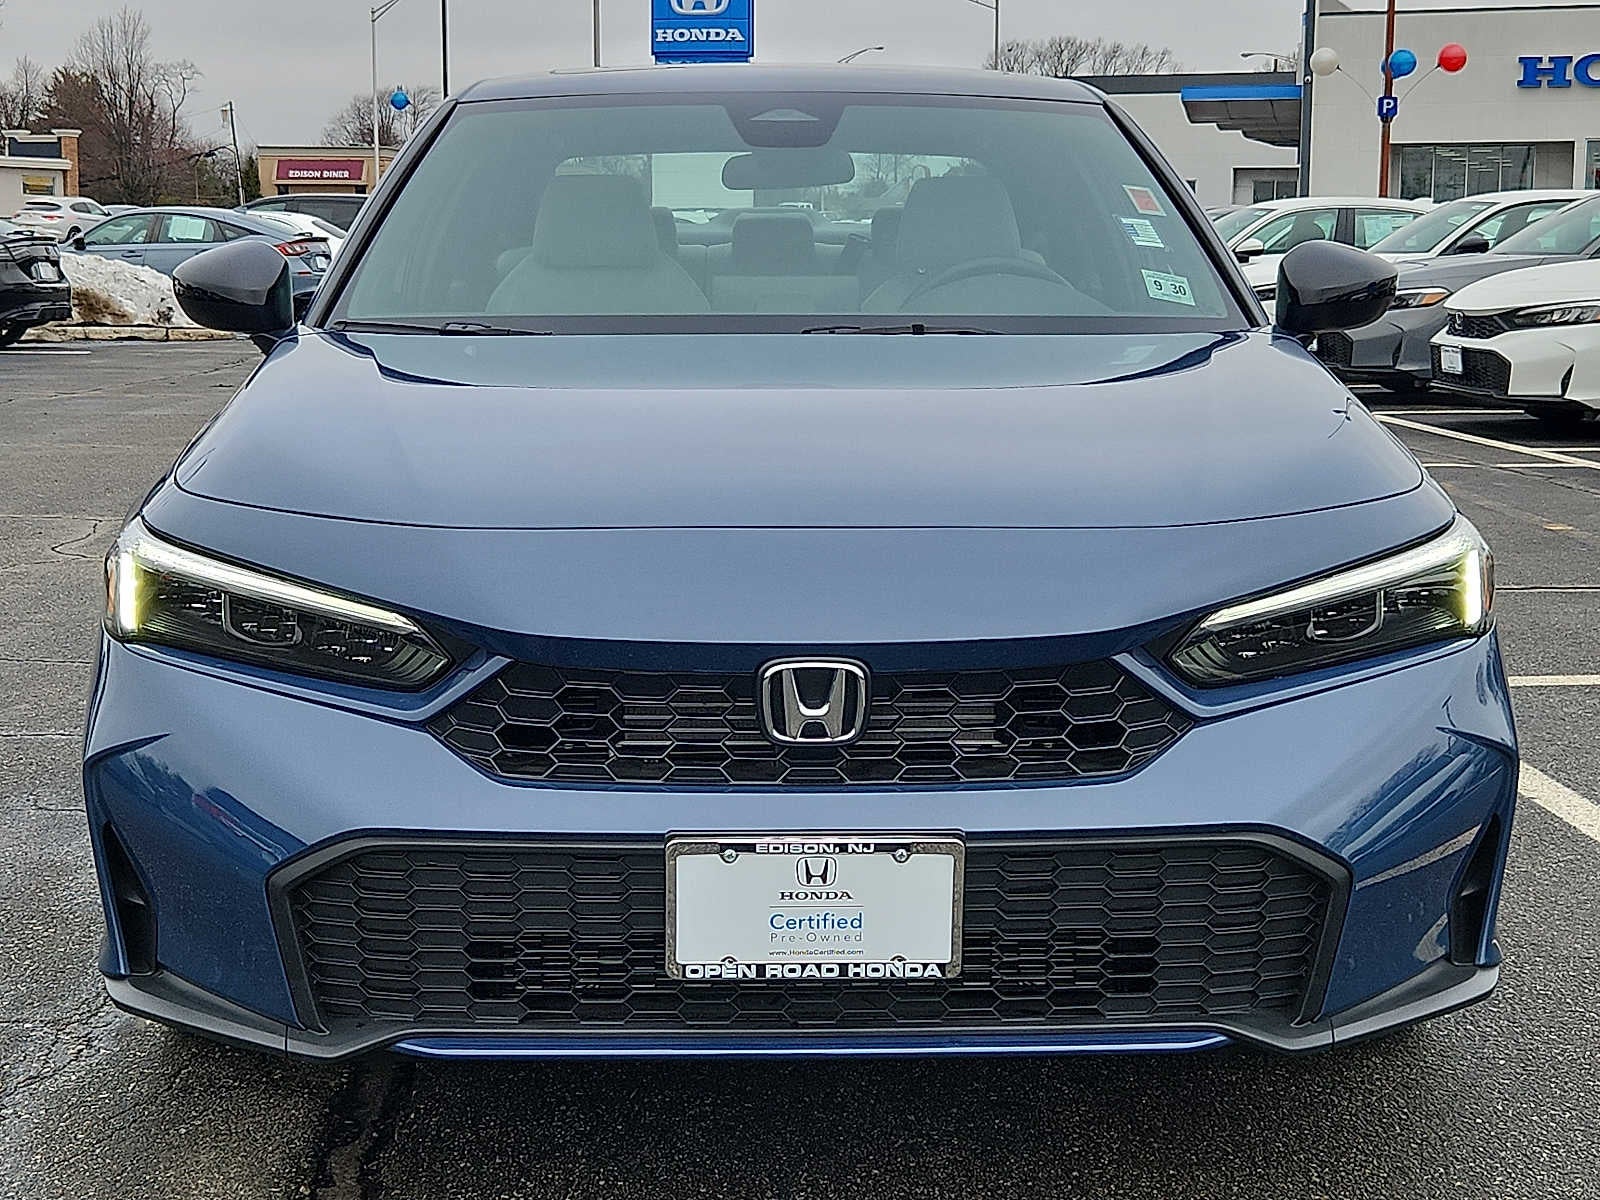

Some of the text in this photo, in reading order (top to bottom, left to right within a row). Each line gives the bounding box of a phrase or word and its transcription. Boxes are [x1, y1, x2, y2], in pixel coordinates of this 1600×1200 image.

[655, 28, 745, 42] HONDA
[1382, 99, 1394, 114] P
[287, 170, 350, 178] EDISON DINER
[1153, 280, 1163, 291] 9
[1170, 283, 1187, 296] 30
[755, 843, 875, 853] EDISON, NJ
[779, 891, 854, 901] HONDA
[769, 912, 863, 930] Certified
[769, 932, 863, 942] Pre-Owned
[685, 963, 942, 978] OPEN ROAD HONDA
